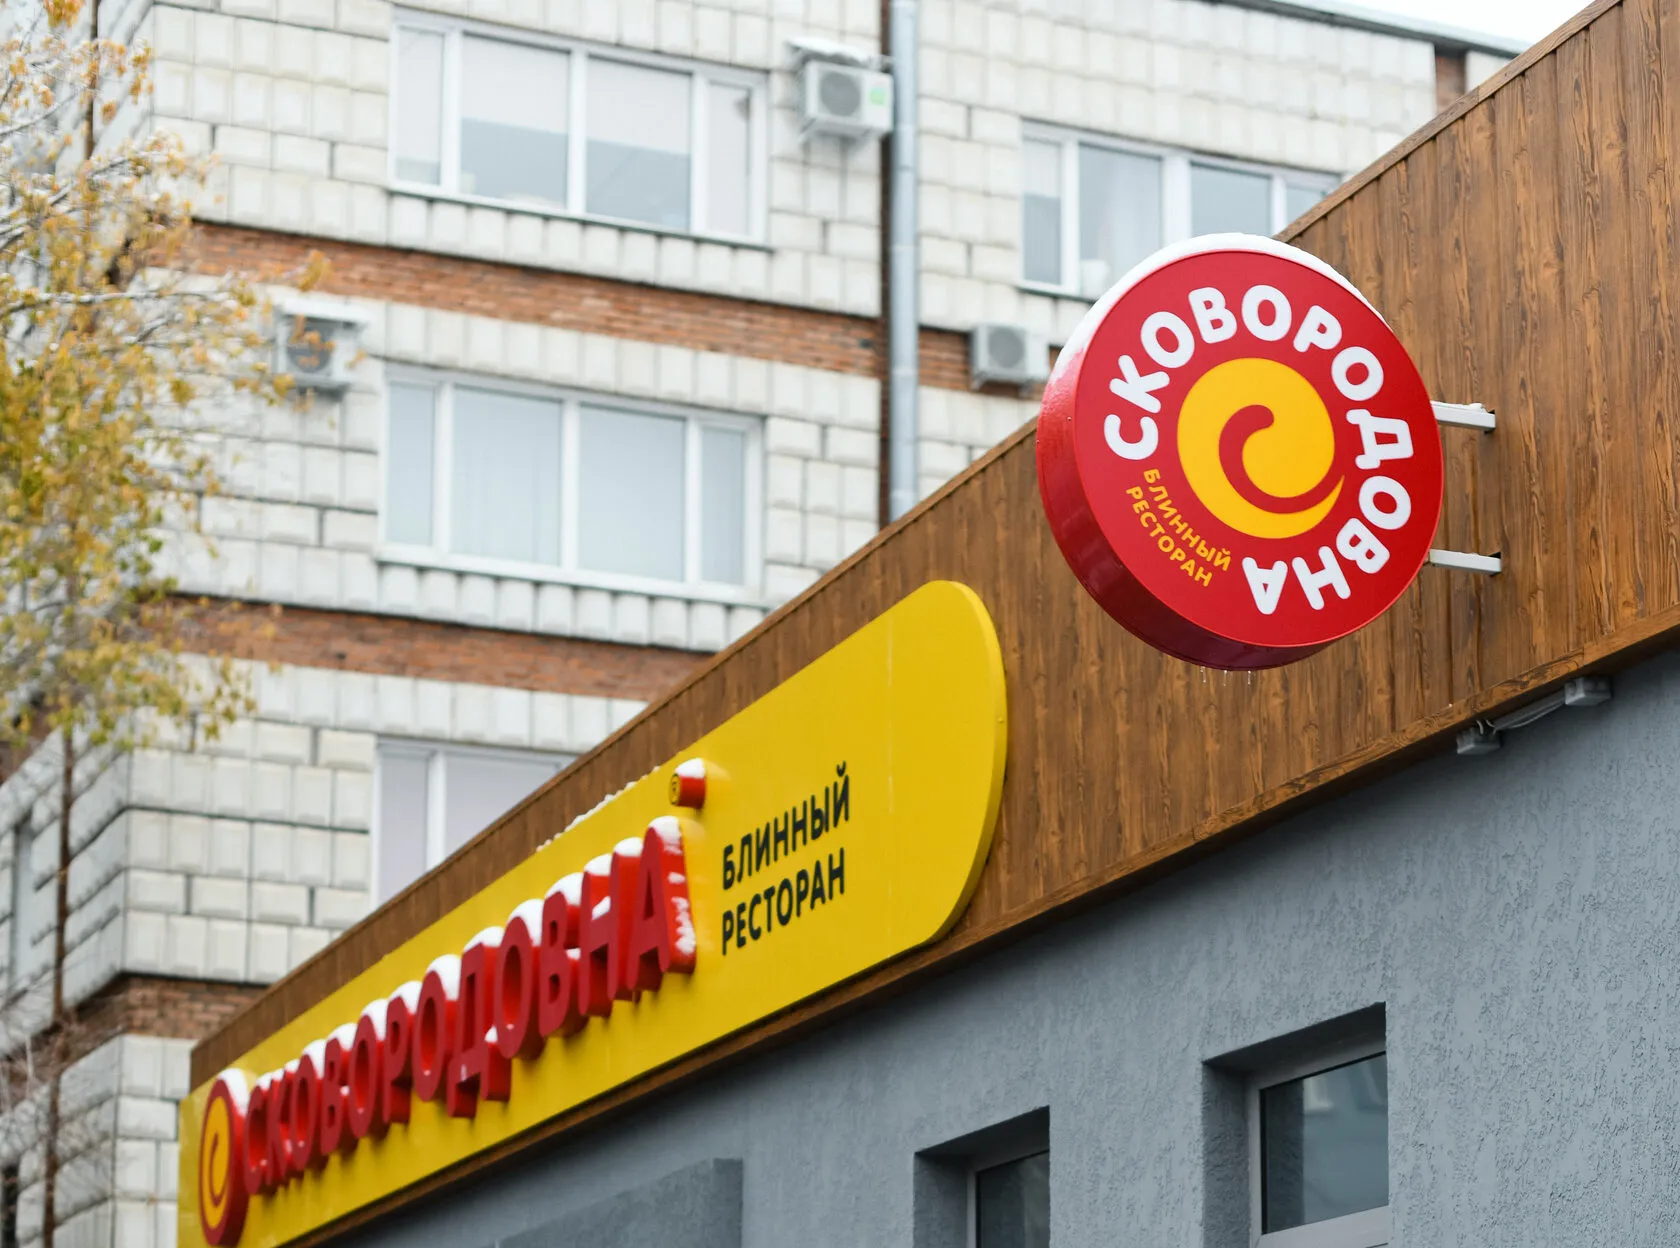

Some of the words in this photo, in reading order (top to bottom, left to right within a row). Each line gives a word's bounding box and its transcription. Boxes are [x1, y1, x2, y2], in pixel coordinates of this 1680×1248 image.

[1103, 284, 1414, 615] СКОВОРОДОВНА
[1126, 484, 1214, 587] РЕСТОРАН
[1143, 468, 1231, 572] БЛИННЫЙ
[723, 761, 850, 891] БЛИННЫЙ
[722, 847, 845, 956] РЕСТОРАН
[244, 818, 694, 1196] СКОВОРОДОВНА
